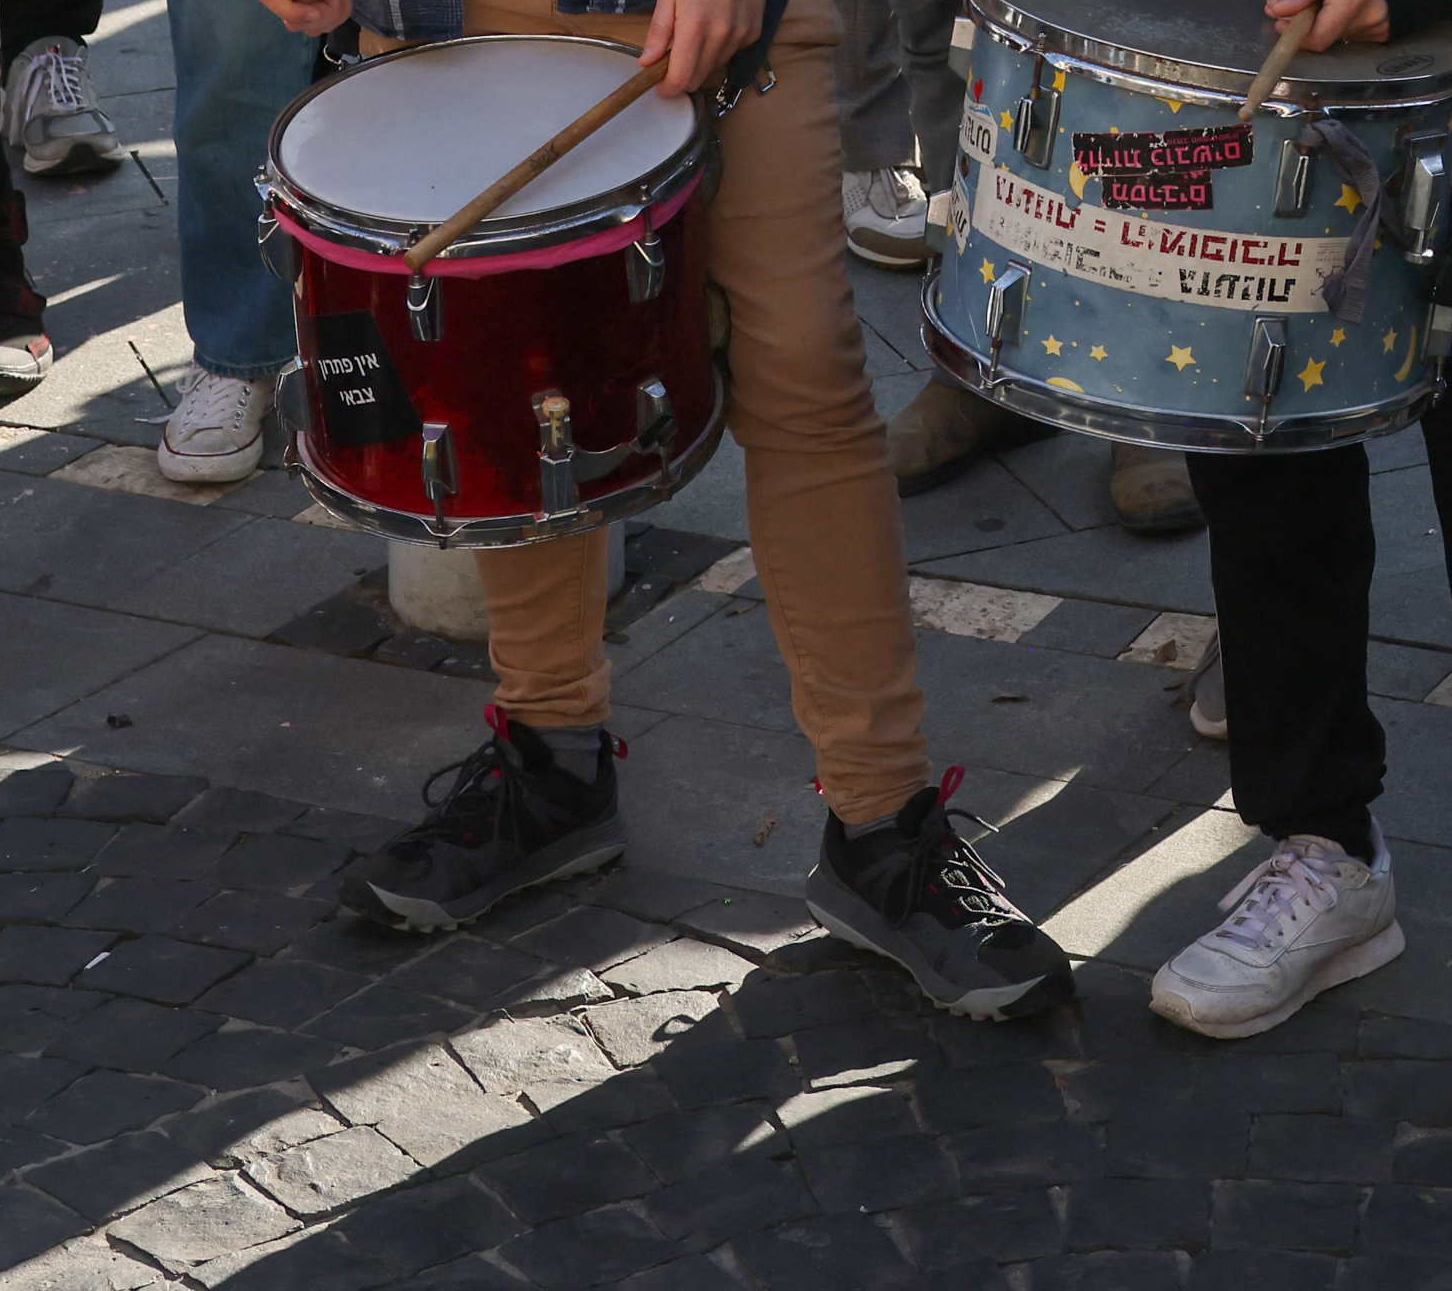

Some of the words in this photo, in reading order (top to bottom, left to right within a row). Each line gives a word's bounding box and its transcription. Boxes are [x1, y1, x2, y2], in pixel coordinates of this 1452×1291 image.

[1150, 141, 1241, 167] כובשים
[1112, 183, 1206, 204] מסרבים
[317, 357, 354, 381] פתרון
[355, 352, 381, 377] אין
[339, 386, 376, 407] צבאי
